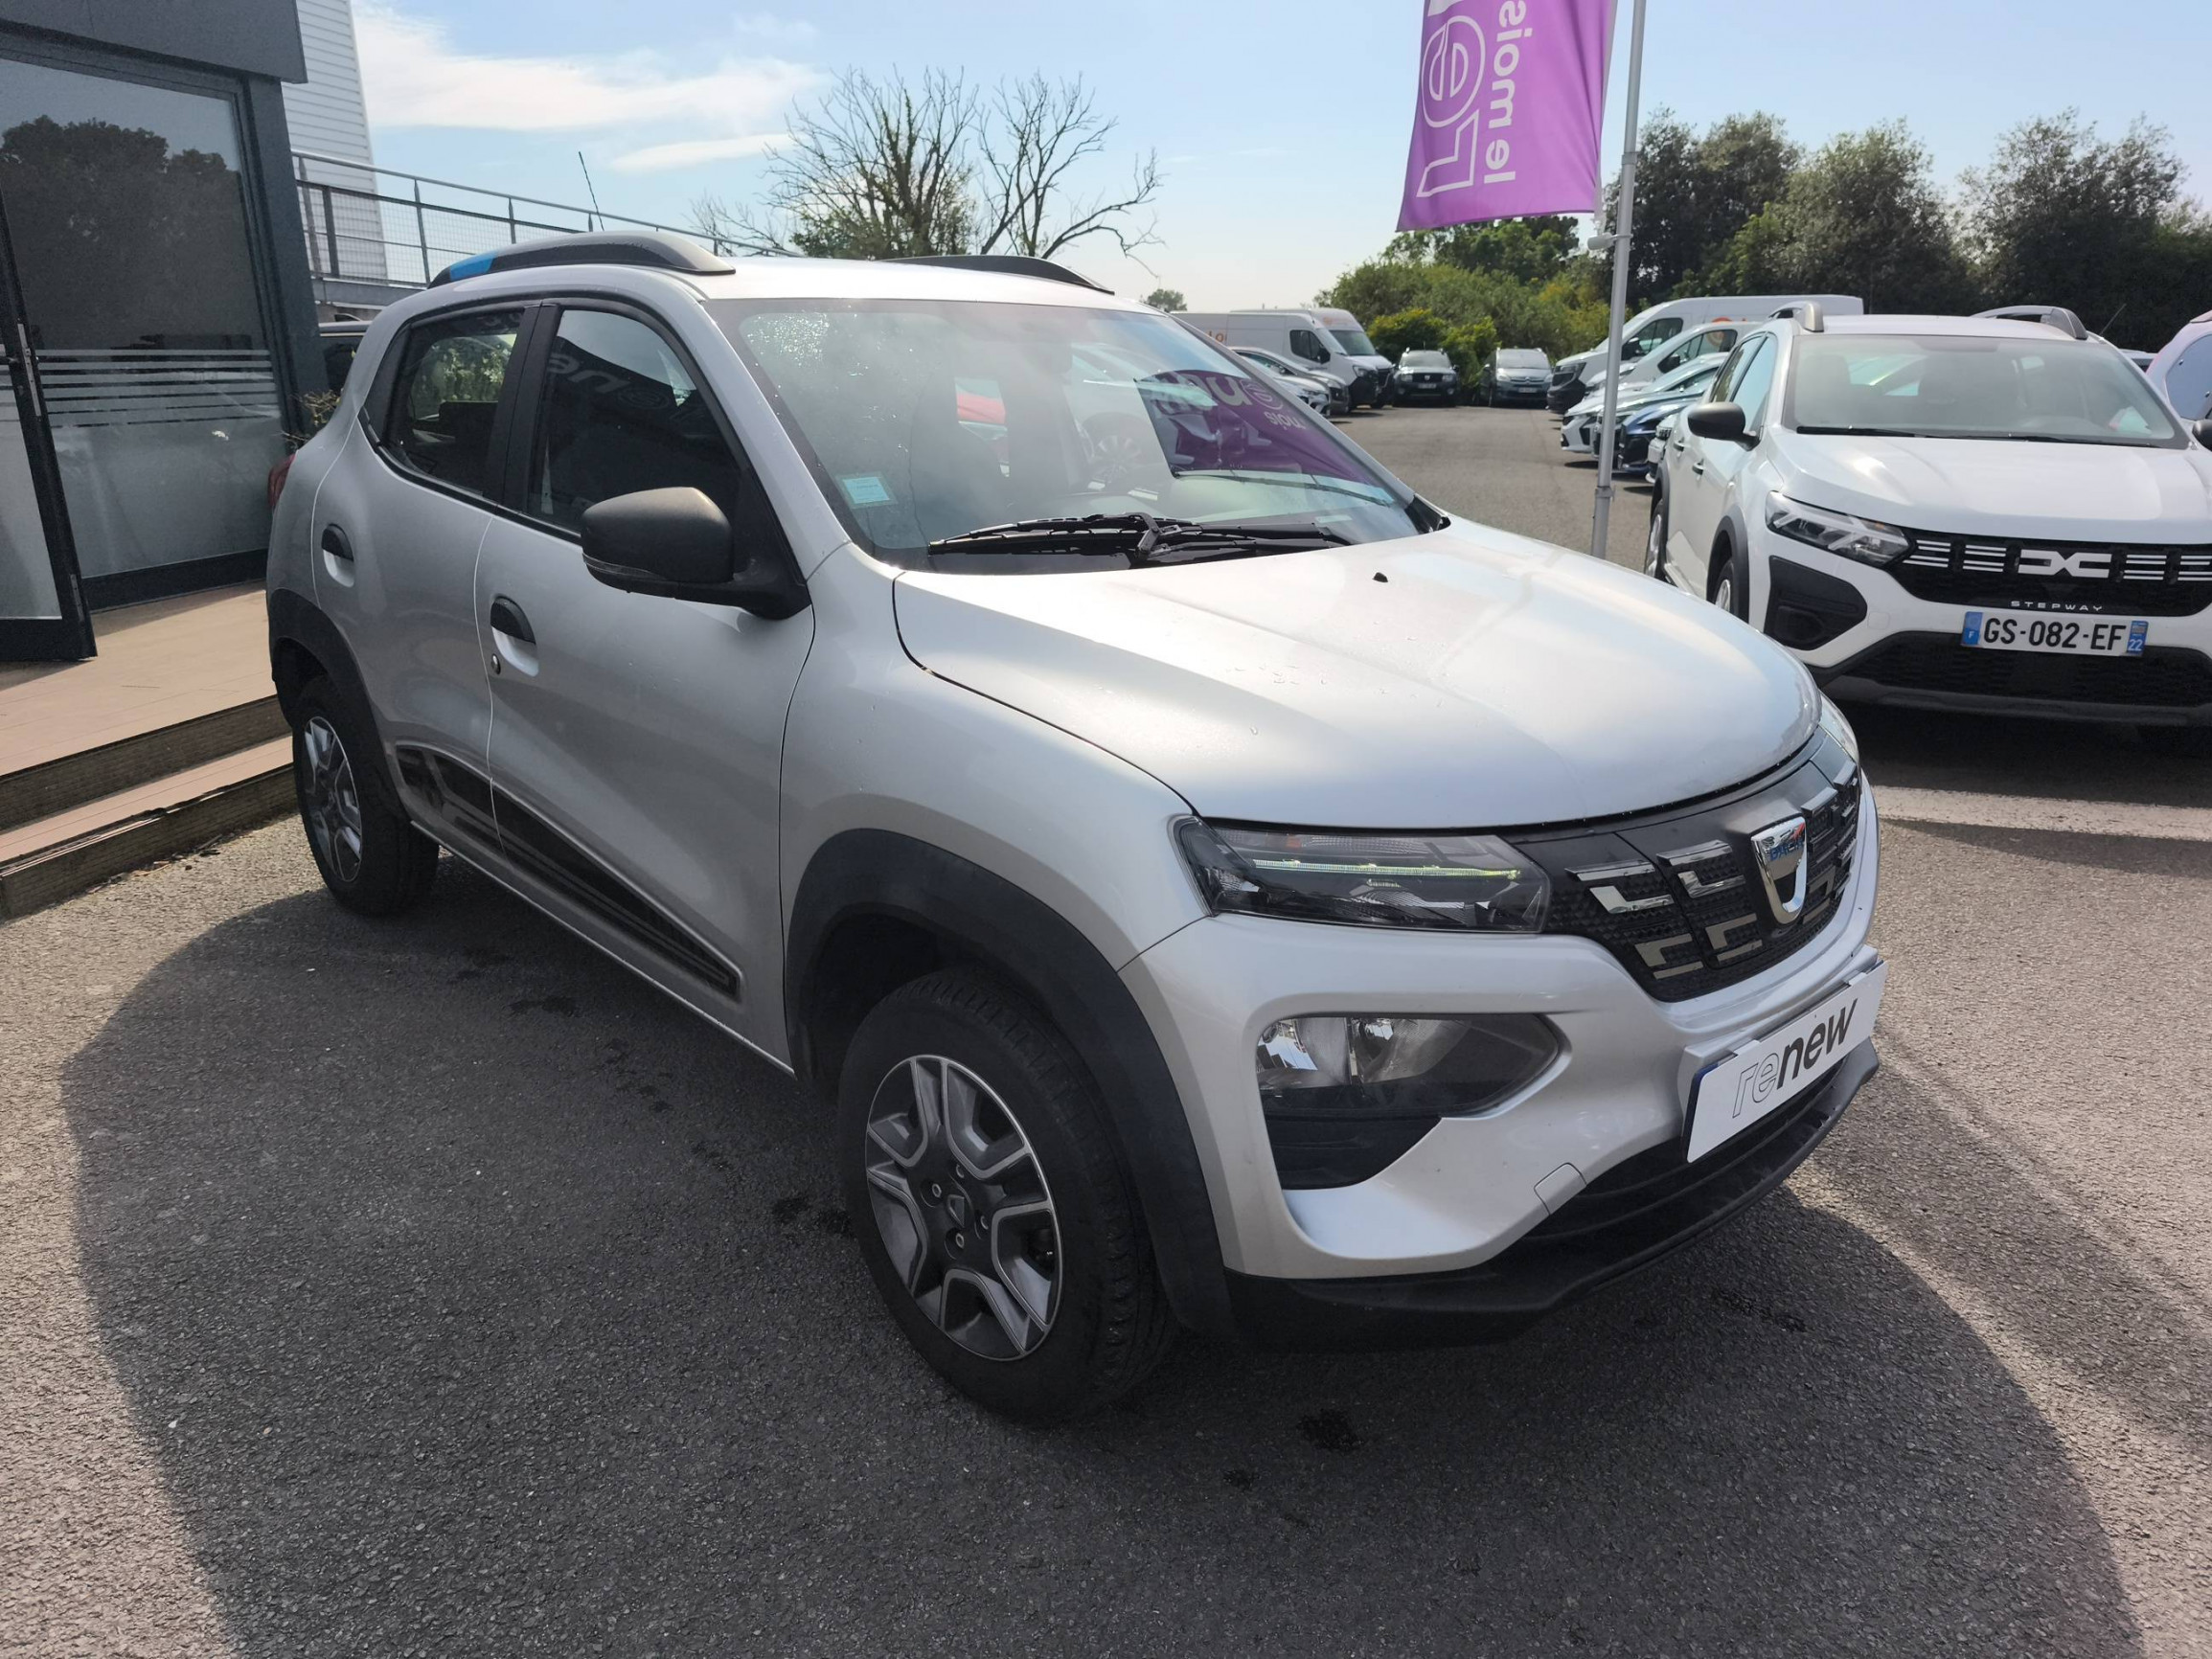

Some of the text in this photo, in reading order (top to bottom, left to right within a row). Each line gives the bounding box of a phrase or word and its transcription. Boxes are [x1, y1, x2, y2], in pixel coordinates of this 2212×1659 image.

[2010, 600, 2104, 612] STEPWAY
[1983, 618, 2127, 650] GS-082-EF
[2127, 638, 2143, 651] 22
[1732, 998, 1859, 1119] renew
